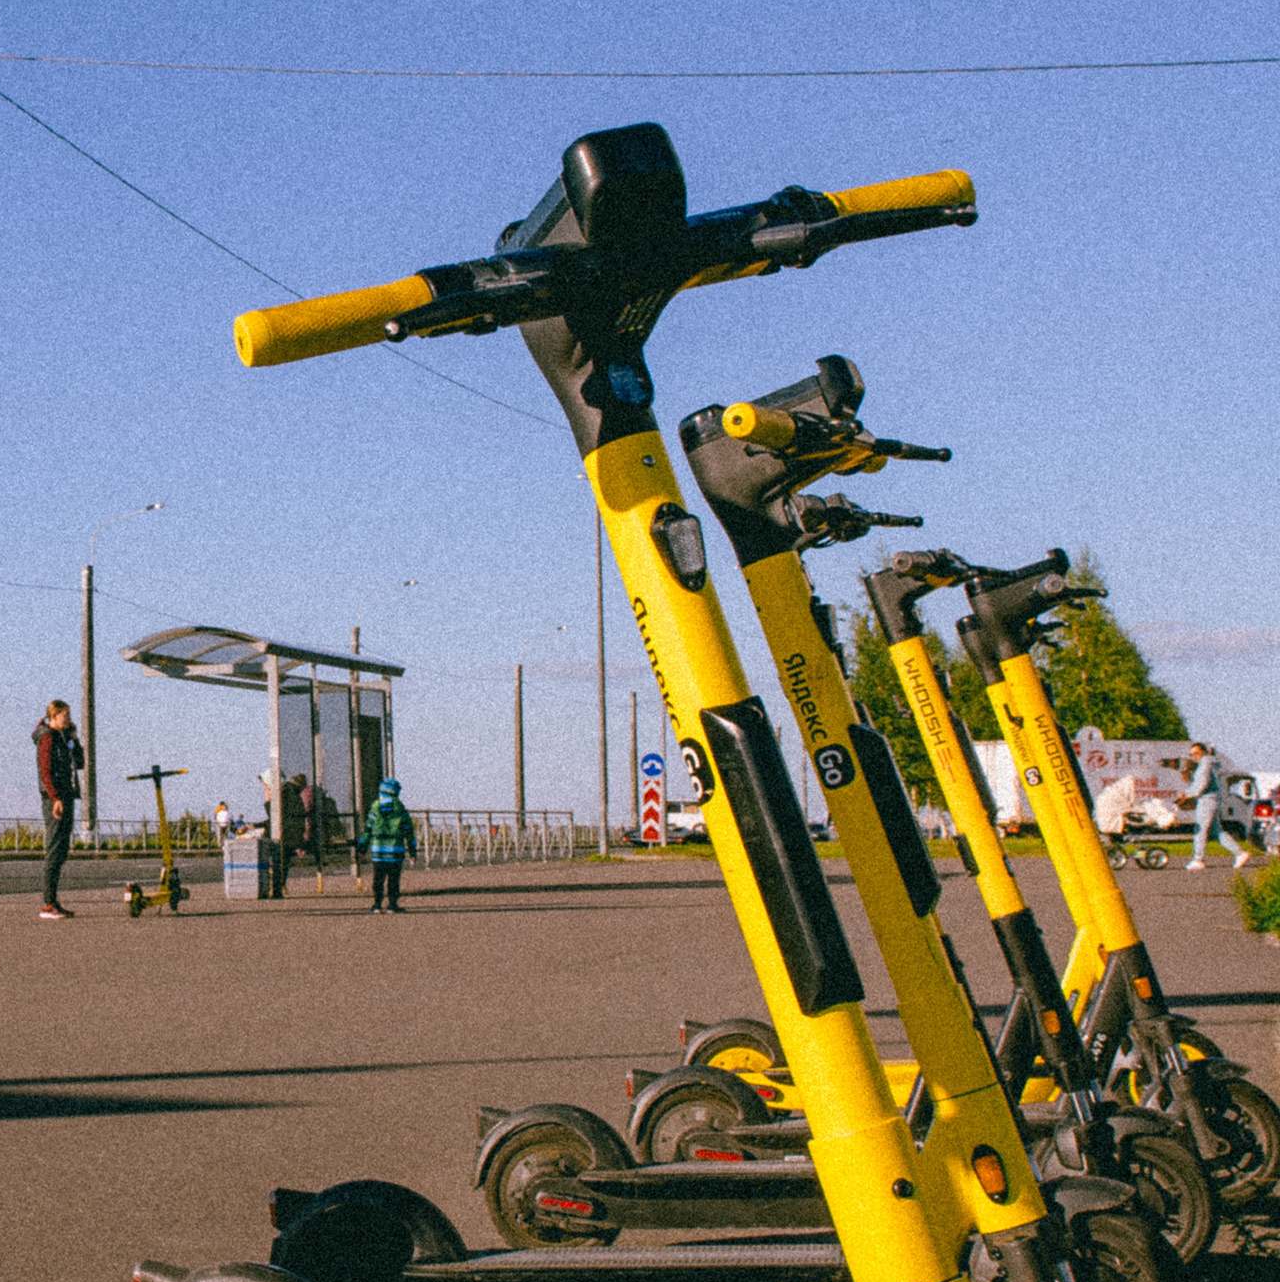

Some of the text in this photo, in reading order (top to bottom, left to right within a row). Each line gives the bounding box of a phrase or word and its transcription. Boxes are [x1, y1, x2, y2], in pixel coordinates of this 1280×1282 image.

[783, 652, 843, 785] Яндекс Go
[903, 657, 947, 746] WHOOSH
[681, 746, 703, 801] Go
[1024, 767, 1041, 786] Go
[1034, 714, 1075, 795] WHOOSH
